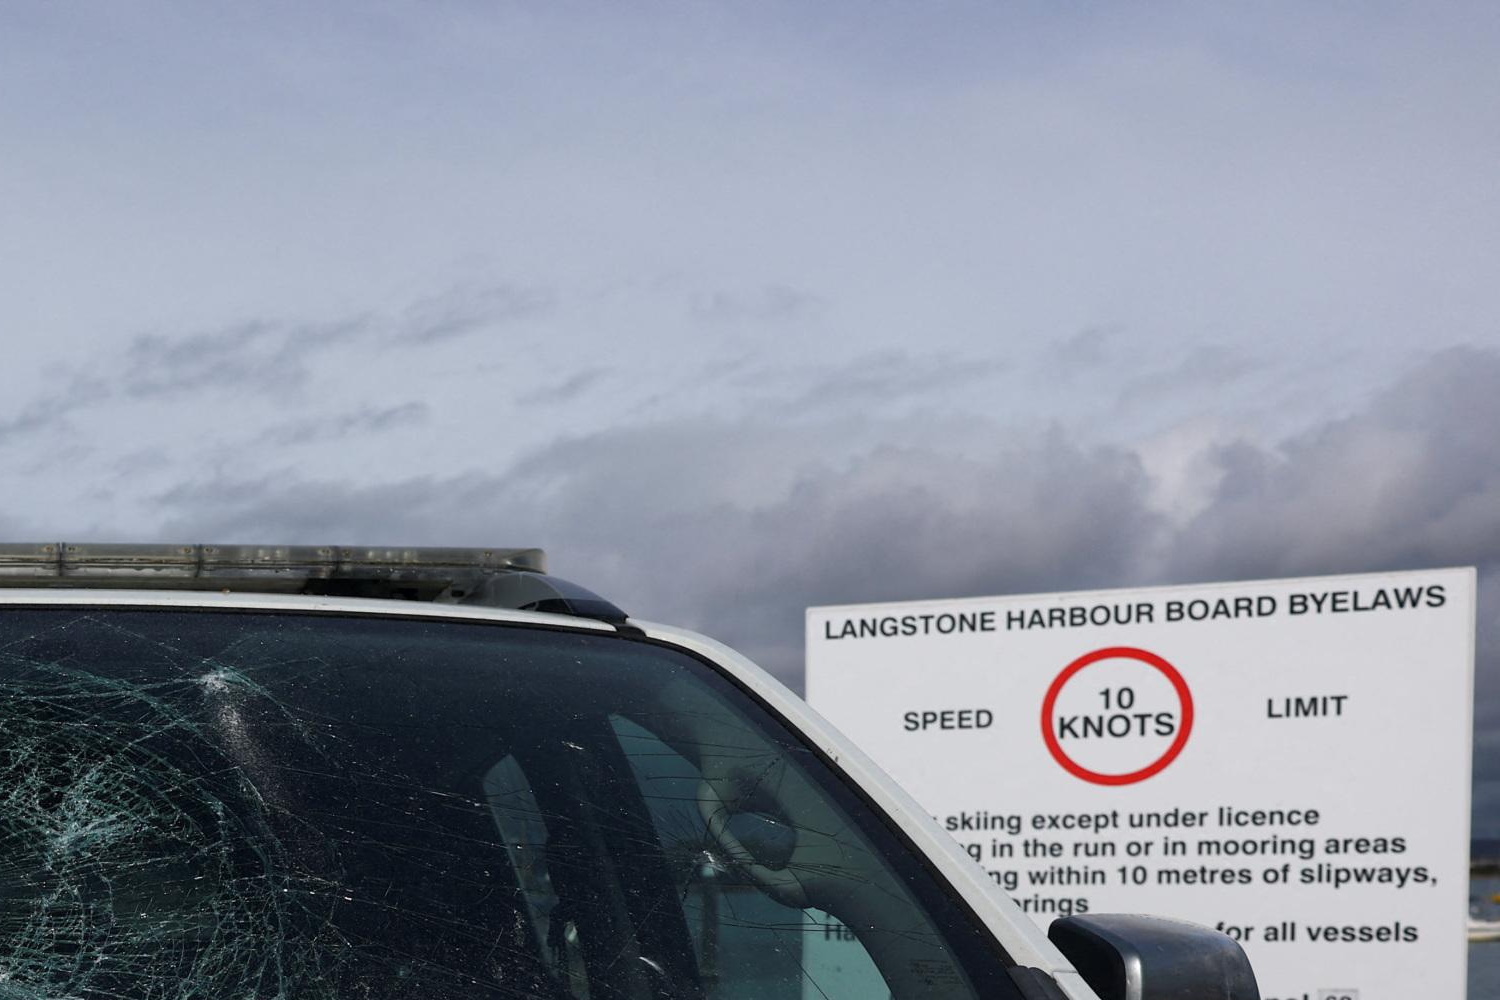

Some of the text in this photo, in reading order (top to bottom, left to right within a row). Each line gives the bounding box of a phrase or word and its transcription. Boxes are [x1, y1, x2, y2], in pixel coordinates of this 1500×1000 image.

[824, 585, 1447, 640] LANGSTONE HARBOUR BOARD BYELAWS
[1099, 686, 1135, 711] 10
[1267, 695, 1349, 719] LIMIT
[903, 709, 994, 732] SPEED
[1057, 711, 1176, 739] KNOTS
[945, 806, 1320, 835] skiing except under licence
[991, 838, 1014, 858] in
[1022, 837, 1064, 858] the
[1073, 841, 1116, 858] run
[1125, 841, 1154, 857] or
[1163, 836, 1187, 857] in
[1197, 834, 1315, 861] mooring
[1324, 837, 1407, 855] areas
[1027, 865, 1106, 886] within
[1117, 865, 1148, 886] 10
[1157, 865, 1253, 885] metres
[1262, 863, 1291, 885] of
[1299, 862, 1438, 888] slipways,
[1013, 893, 1091, 918] rings
[1263, 921, 1296, 942] all
[1306, 921, 1419, 943] vessels
